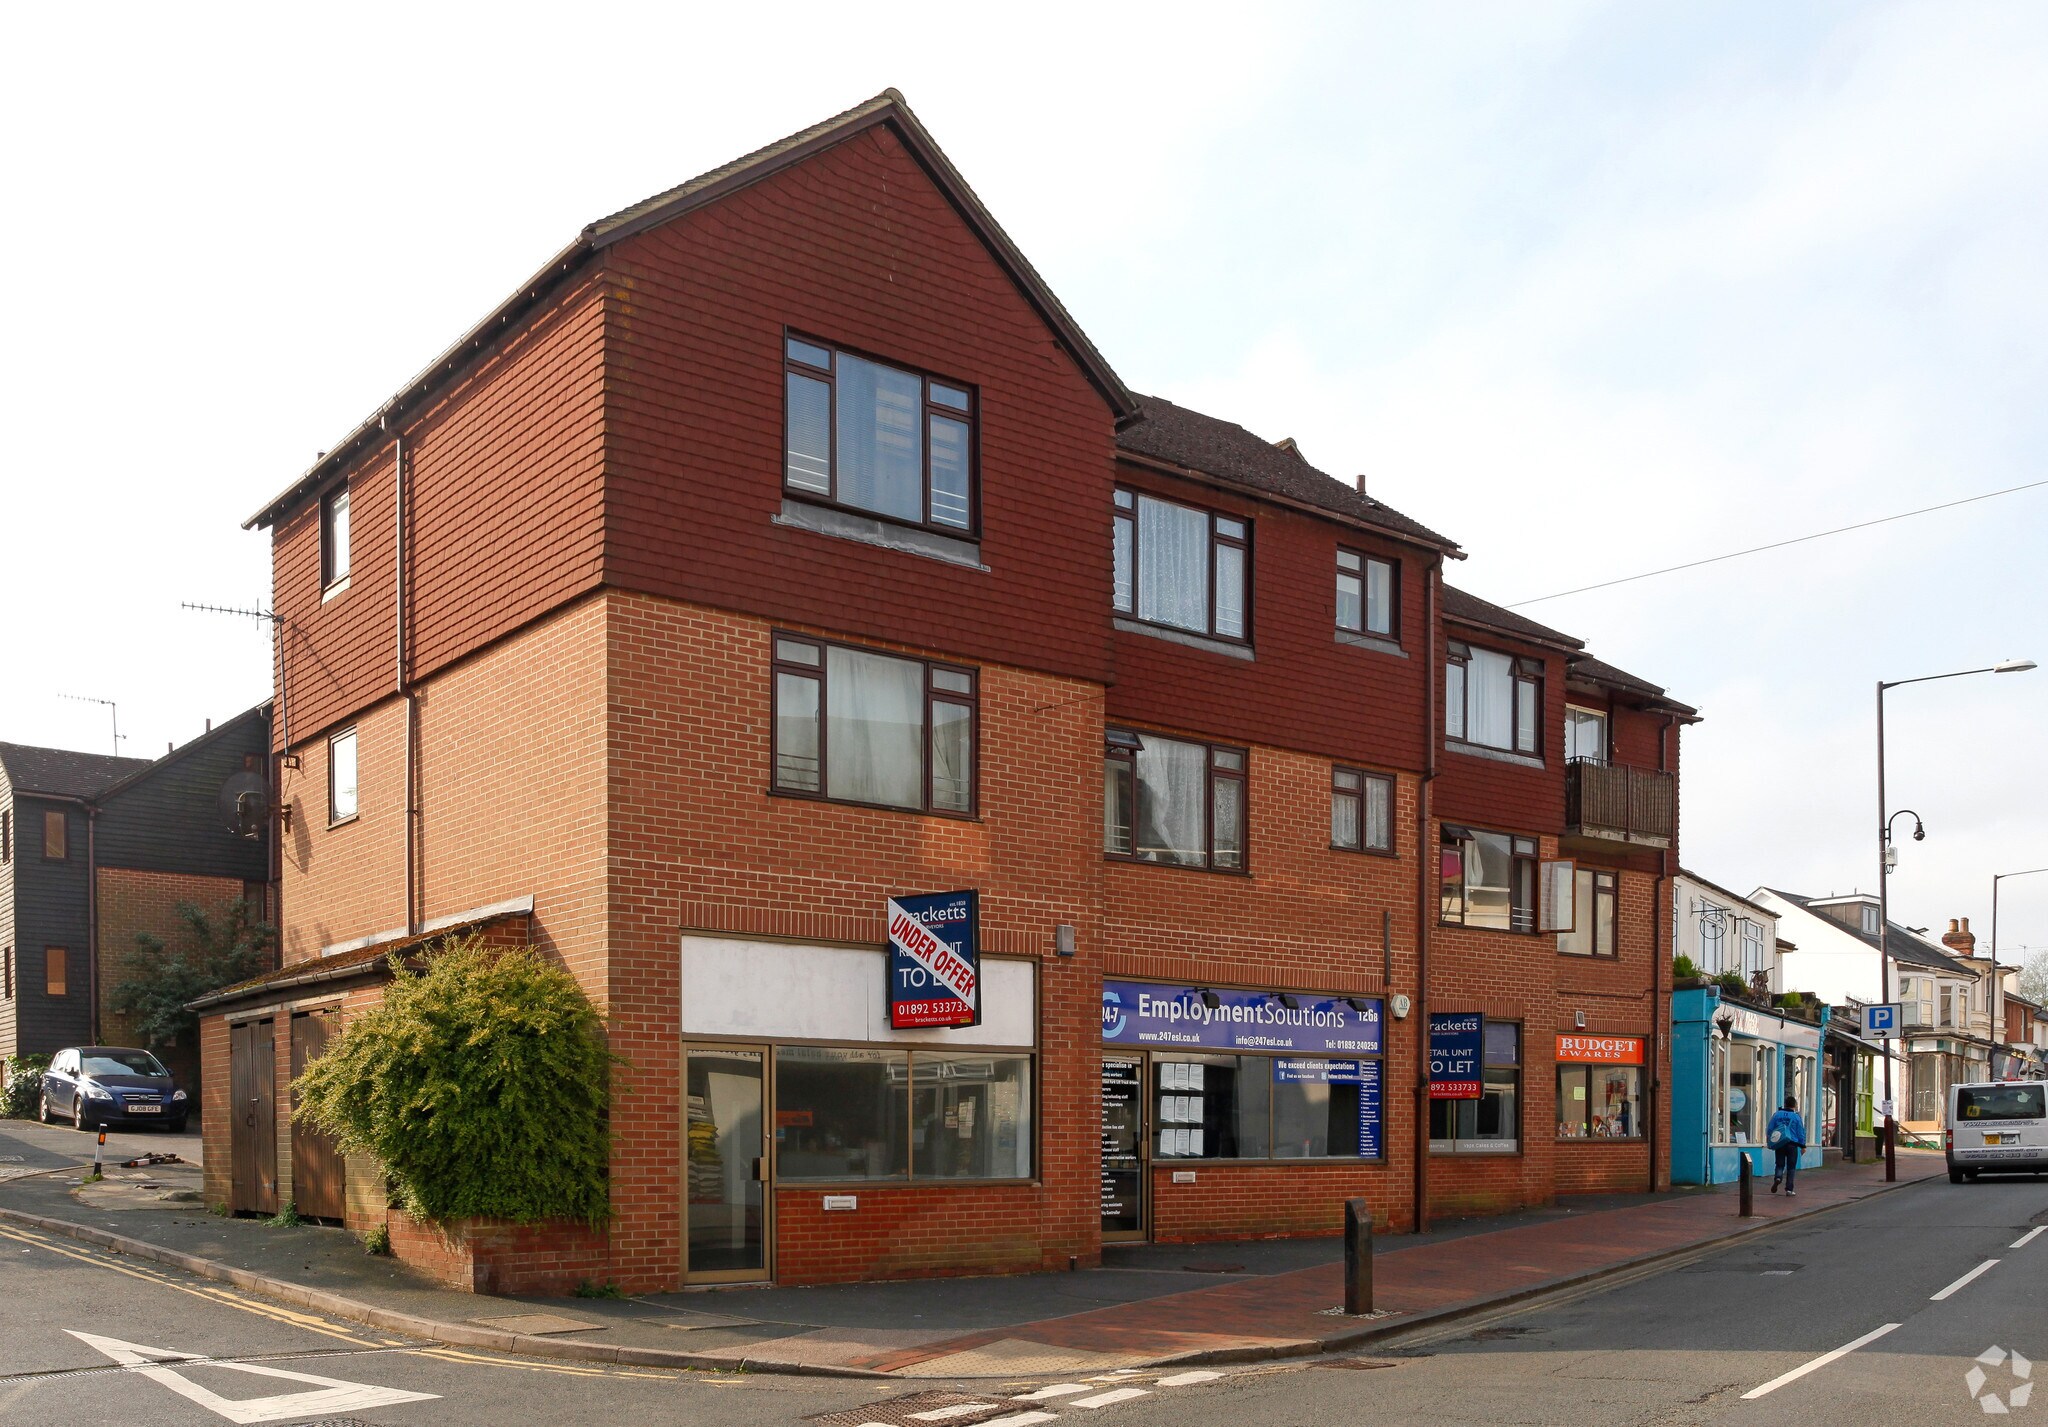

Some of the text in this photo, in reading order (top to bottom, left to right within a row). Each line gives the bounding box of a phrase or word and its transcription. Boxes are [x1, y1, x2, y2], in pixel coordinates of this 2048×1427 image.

[890, 914, 976, 997] UNDER OFFER
[899, 967, 926, 988] TO
[899, 1001, 969, 1015] 01892 533733
[1875, 1010, 1889, 1027] P
[1430, 1020, 1478, 1031] racketts
[1139, 1032, 1200, 1043] www.247esl.co.uk
[1236, 1036, 1293, 1047] info@247esl.co.uk
[1325, 1039, 1336, 1049] Tel:
[1357, 1041, 1378, 1051] 240250
[1561, 1038, 1637, 1052] BUDGET
[1278, 1061, 1287, 1069] We
[1307, 1062, 1324, 1070] clients
[1324, 1062, 1355, 1071] expectations
[1430, 1061, 1474, 1073] O LET
[1448, 1083, 1477, 1091] 533733
